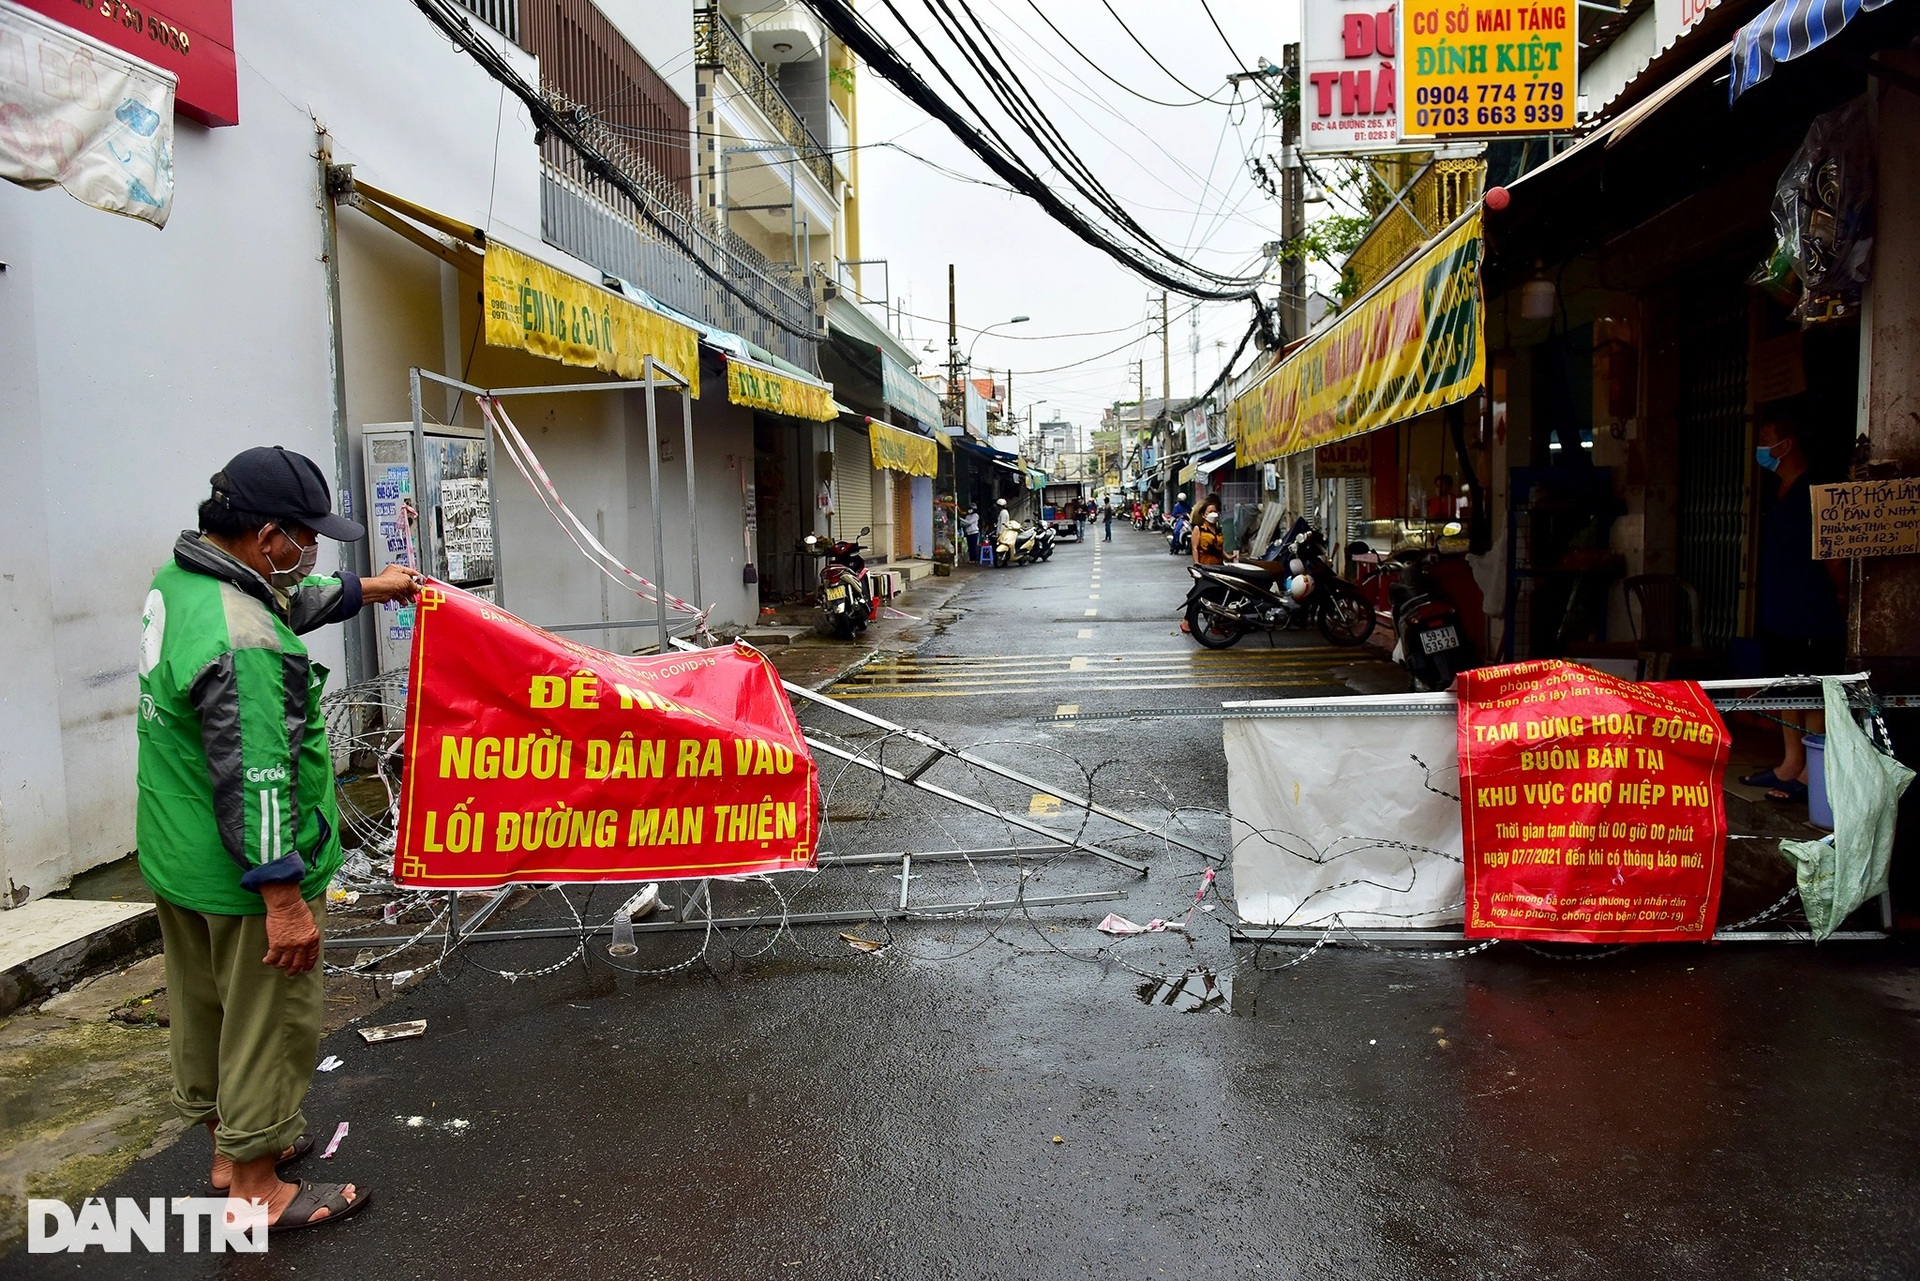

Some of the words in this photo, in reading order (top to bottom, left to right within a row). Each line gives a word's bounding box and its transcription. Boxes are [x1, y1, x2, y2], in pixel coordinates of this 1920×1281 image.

[1413, 8, 1439, 35] CƠ
[1445, 3, 1470, 34] SỞ
[1476, 10, 1511, 32] MAI
[1517, 2, 1566, 31] TÁNG
[147, 15, 190, 56] 5039
[1496, 34, 1562, 80] KIỆT
[1416, 86, 1469, 105] 0904
[1477, 84, 1516, 103] 774
[1525, 82, 1564, 101] 779
[1327, 121, 1338, 130] 4A
[1339, 117, 1366, 129] ĐƯỜNG
[1416, 108, 1469, 127] 0703
[1477, 106, 1516, 125] 663
[1524, 104, 1564, 123] 939
[1354, 131, 1367, 141] ĐT:
[1368, 131, 1388, 140] 0283
[1821, 506, 1839, 521] CÓ
[1844, 504, 1870, 522] BÁN
[1425, 636, 1457, 653] 53529
[660, 657, 717, 679] COVID-19
[1542, 658, 1563, 672] bảo
[1500, 680, 1543, 695] phòng,
[1546, 670, 1585, 686] chống
[1479, 699, 1494, 710] và
[1497, 698, 1520, 709] hạn
[1523, 690, 1547, 704] chế
[1550, 690, 1567, 701] lây
[1571, 686, 1591, 697] lan
[1595, 685, 1629, 699] trong
[1474, 724, 1519, 746] TẠM
[1526, 715, 1584, 740] DỪNG
[1592, 713, 1648, 739] HOẠT
[1652, 715, 1714, 745] ĐỘNG
[439, 728, 573, 780] NGƯỜI
[584, 731, 667, 780] DÂN
[677, 738, 723, 778] RA
[1521, 745, 1582, 772] BUÔN
[1586, 745, 1630, 770] BÁN
[1635, 747, 1665, 775] TẠI
[246, 763, 286, 783] Grab
[1478, 787, 1518, 807] KHU
[1524, 780, 1566, 810] VỰC
[1568, 780, 1614, 809] CHỢ
[1618, 778, 1666, 810] HIỆP
[1672, 780, 1710, 808] PHÚ
[424, 796, 485, 853] LỐI
[495, 800, 617, 851] ĐƯỜNG
[628, 805, 704, 847] MAN
[714, 795, 797, 850] THIỆN
[1496, 822, 1519, 839] Thời
[1522, 825, 1545, 842] gian
[1547, 824, 1566, 842] tạm
[1569, 820, 1596, 842] dừng
[1598, 820, 1609, 839] từ
[1612, 823, 1627, 839] 00
[1629, 822, 1649, 843] giờ
[1667, 825, 1694, 843] phút
[1484, 851, 1510, 869] ngày
[1511, 848, 1562, 866] 07/7/2021
[1565, 848, 1586, 867] đến
[1588, 848, 1603, 866] khi
[1607, 849, 1621, 867] có
[1623, 848, 1654, 870] thông
[1657, 850, 1678, 868] báo
[1681, 851, 1705, 870] mới.
[1516, 894, 1543, 906] mong
[1560, 897, 1577, 906] con
[1598, 896, 1631, 909] thương
[1633, 896, 1642, 906] và
[1490, 907, 1509, 918] hợp
[1510, 907, 1525, 917] tác
[1525, 908, 1559, 922] phòng,
[1561, 909, 1592, 923] chống
[1594, 911, 1614, 923] dịch
[1616, 911, 1638, 923] bệnh
[1638, 910, 1685, 923] COVID-19)
